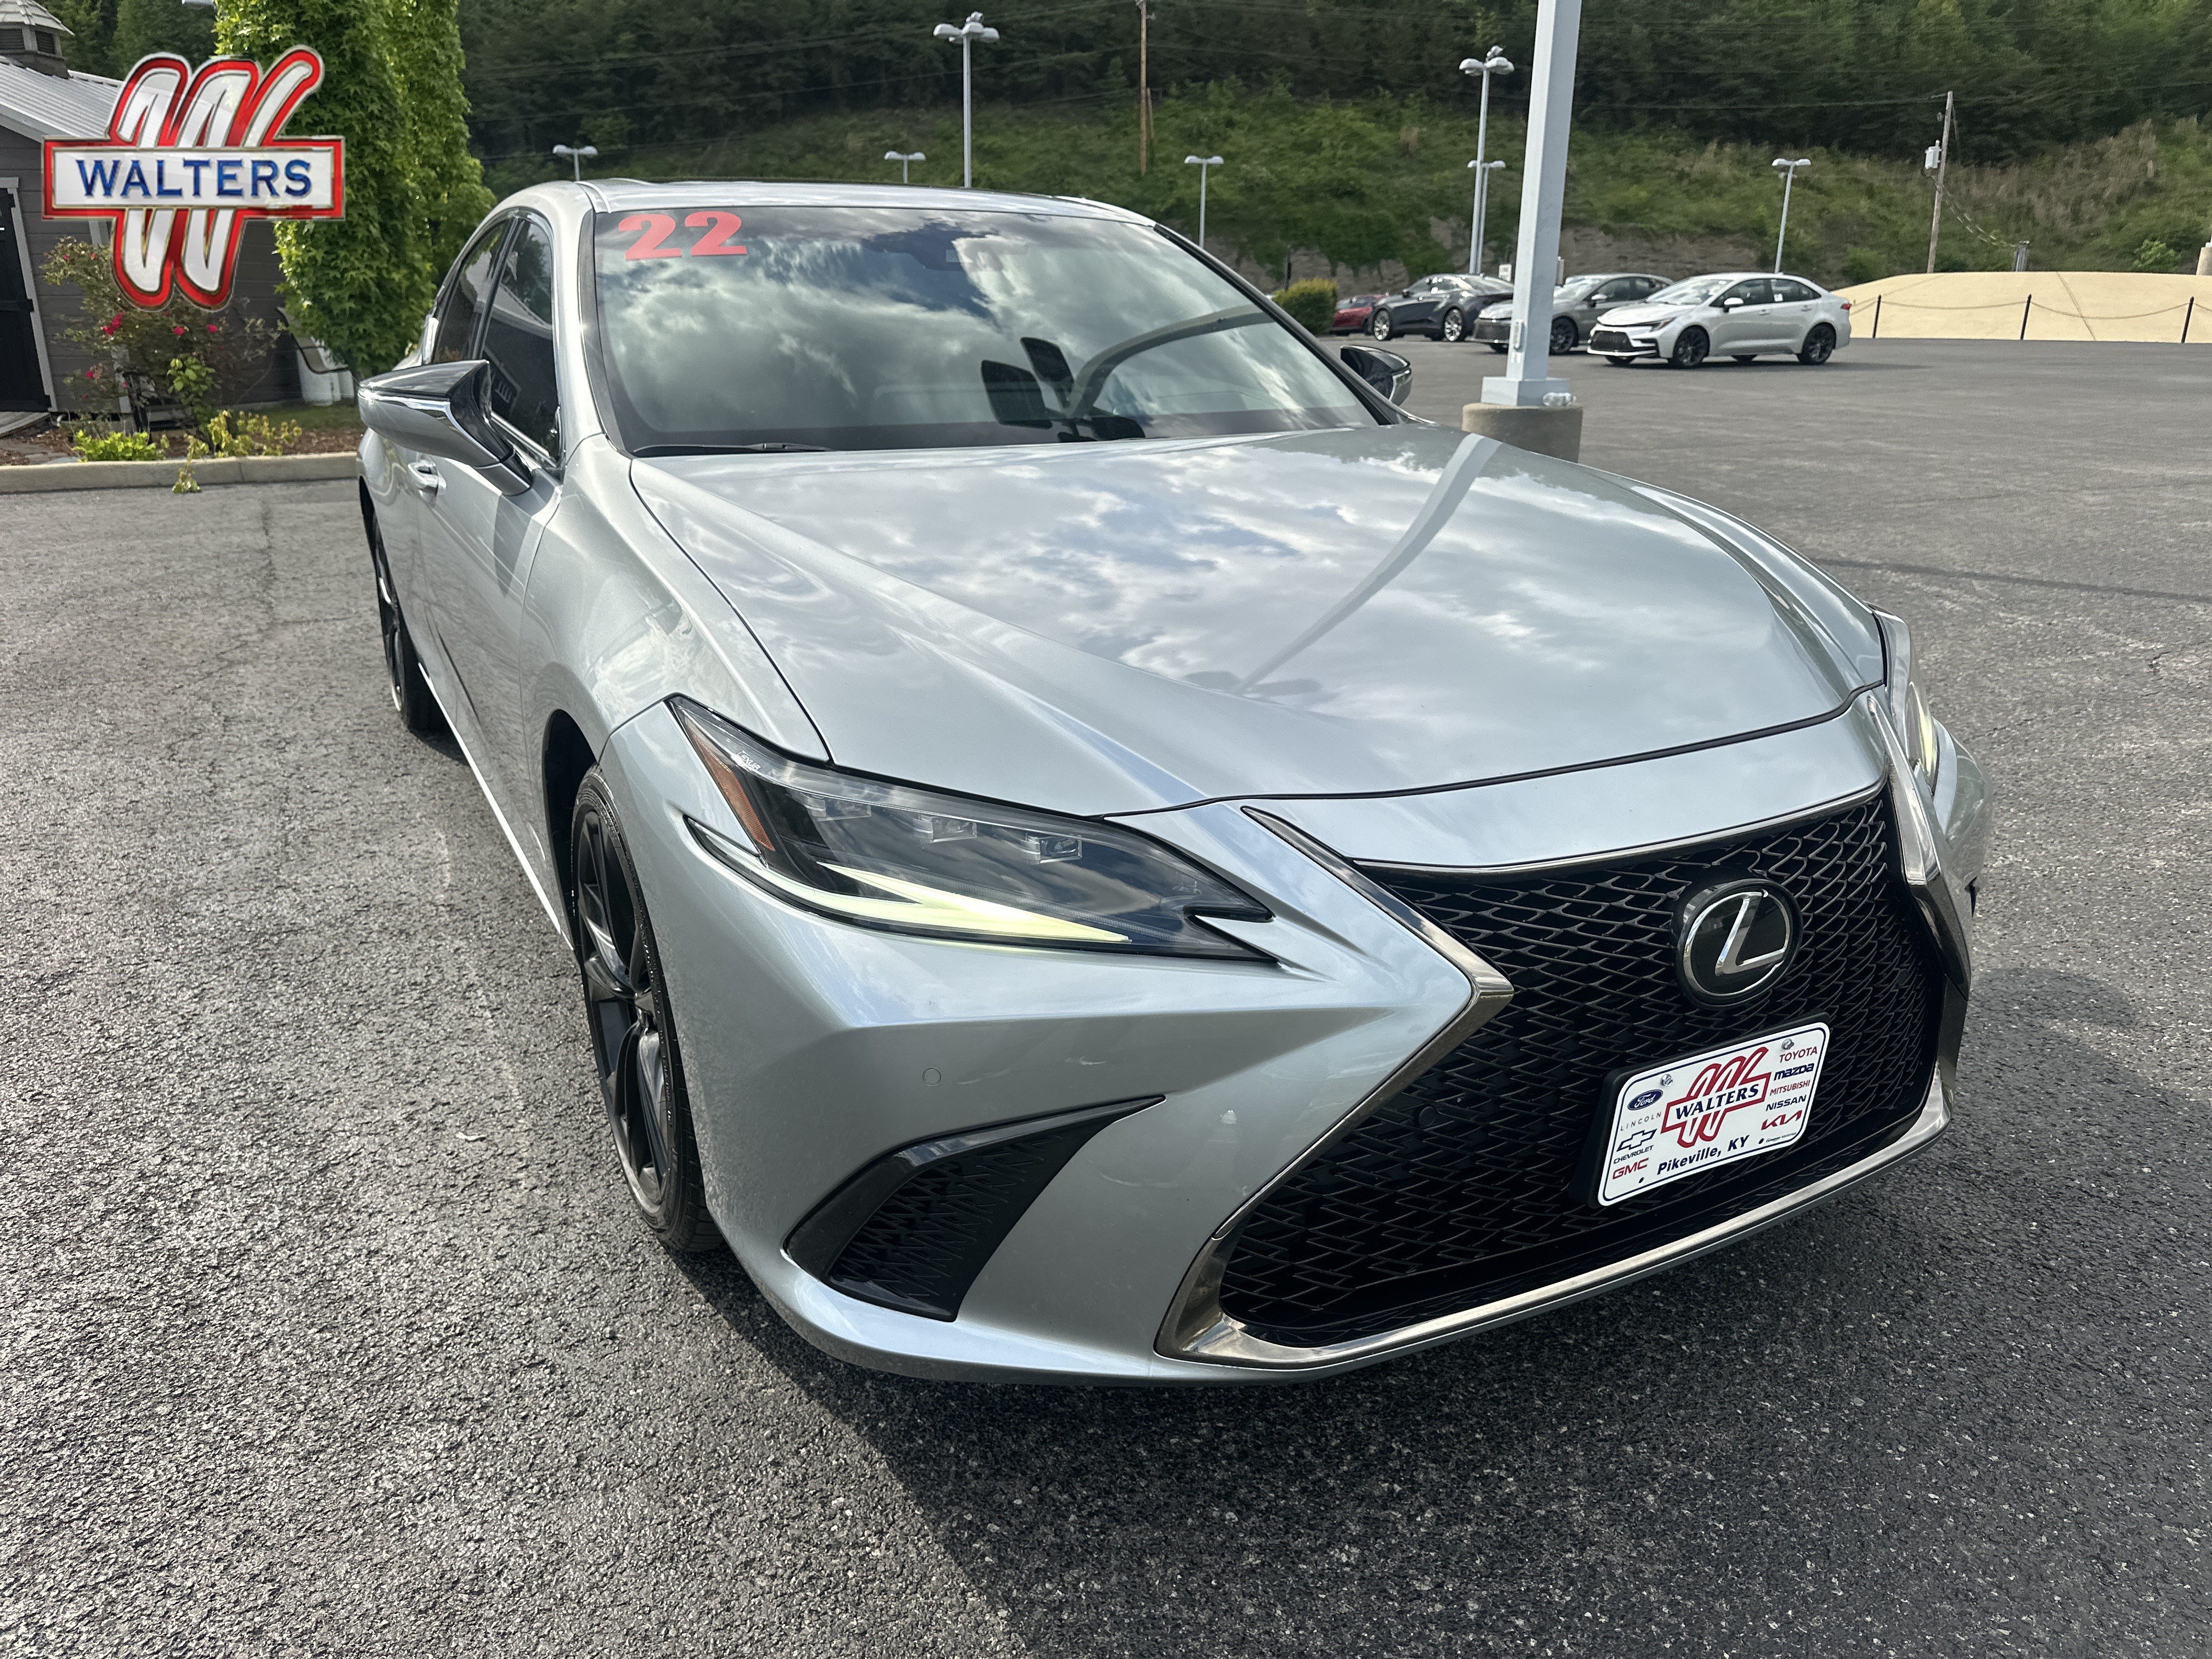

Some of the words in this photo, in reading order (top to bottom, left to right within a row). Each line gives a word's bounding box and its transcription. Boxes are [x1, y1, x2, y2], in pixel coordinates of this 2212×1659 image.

[618, 211, 747, 260] 22
[1779, 1046, 1818, 1063] TOYOTA
[1769, 1080, 1811, 1096] MITSUBISHI
[1634, 1093, 1657, 1109] Ford
[1675, 1084, 1759, 1120] WALTERS
[1765, 1094, 1807, 1111] NISSAN
[1620, 1111, 1662, 1131] LINCOLN
[1761, 1109, 1803, 1131] KIA
[1613, 1145, 1654, 1164] CHEVROLET
[1657, 1147, 1722, 1175] Pikeville,
[1728, 1135, 1750, 1152] KY
[1612, 1158, 1649, 1180] GMC
